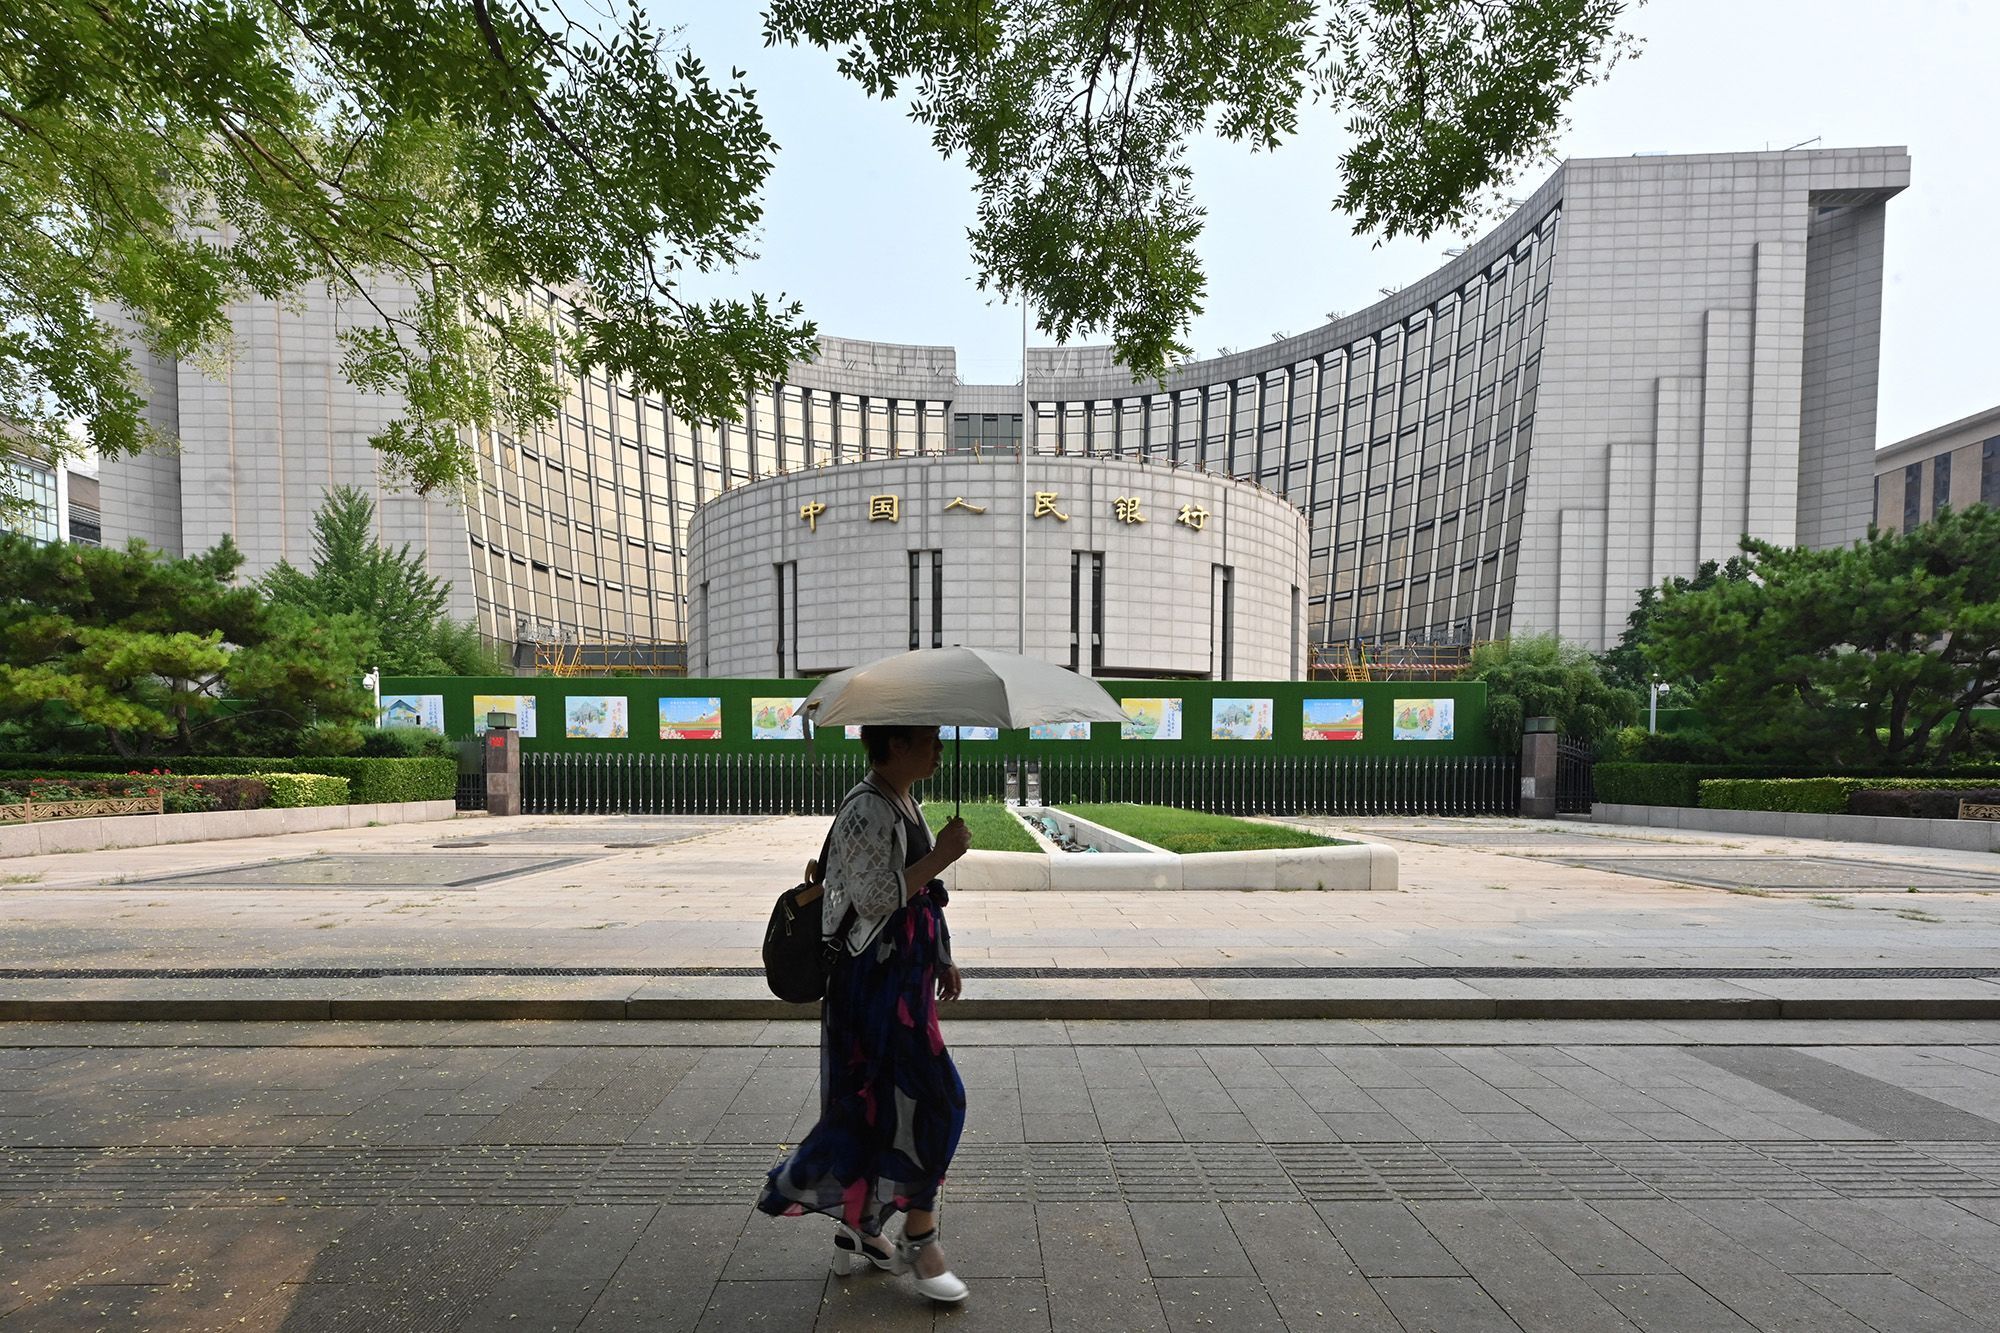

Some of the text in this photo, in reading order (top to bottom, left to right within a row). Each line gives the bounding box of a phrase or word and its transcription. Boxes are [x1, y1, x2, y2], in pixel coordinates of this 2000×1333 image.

[800, 491, 1210, 532] 中国人民银行
